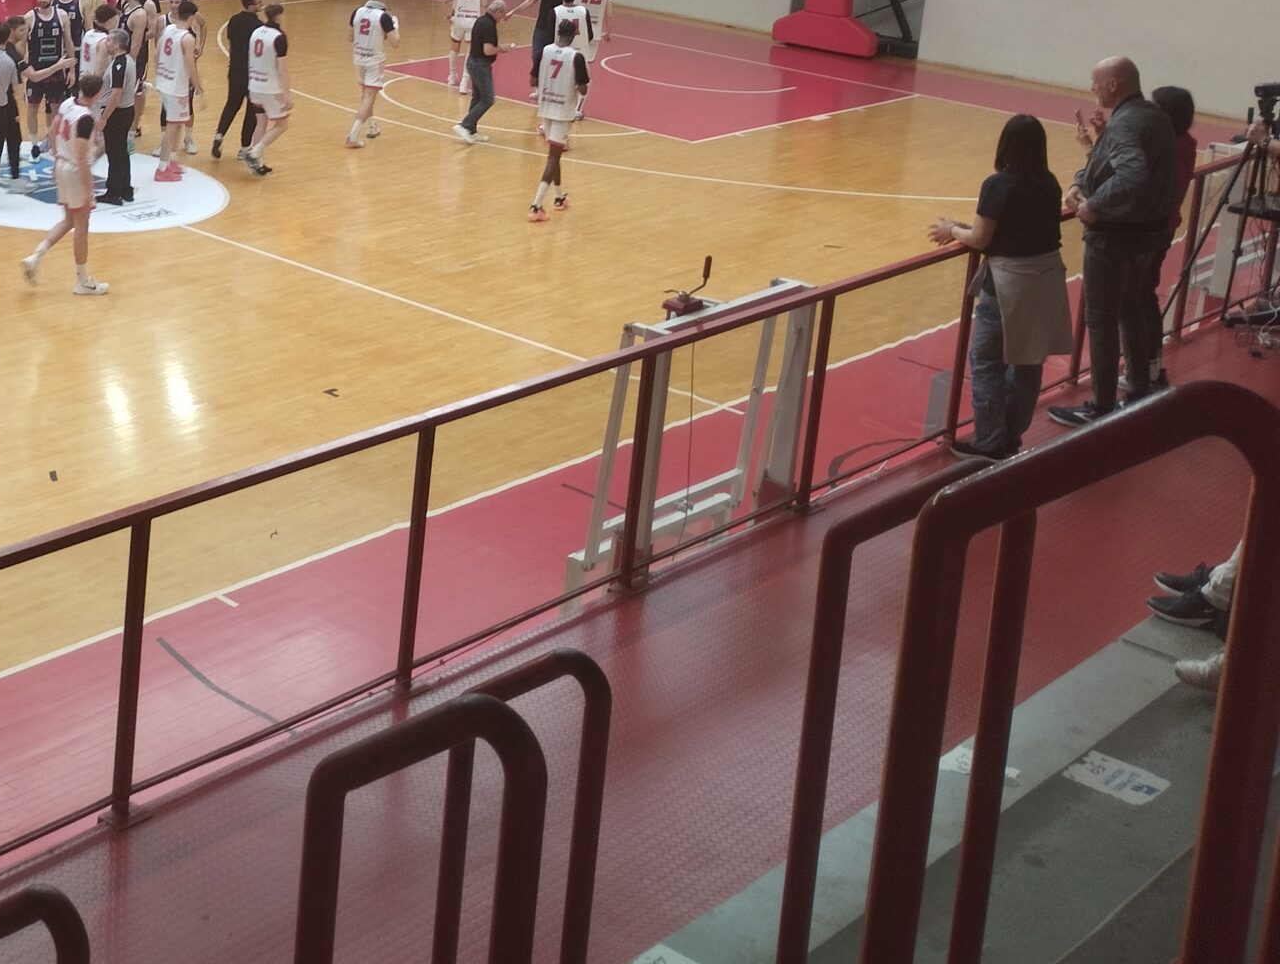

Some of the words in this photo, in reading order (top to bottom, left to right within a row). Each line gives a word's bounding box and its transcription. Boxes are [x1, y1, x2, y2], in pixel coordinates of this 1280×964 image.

[360, 18, 371, 35] 2
[164, 37, 174, 56] 6
[254, 39, 264, 57] 0
[550, 59, 565, 79] 7
